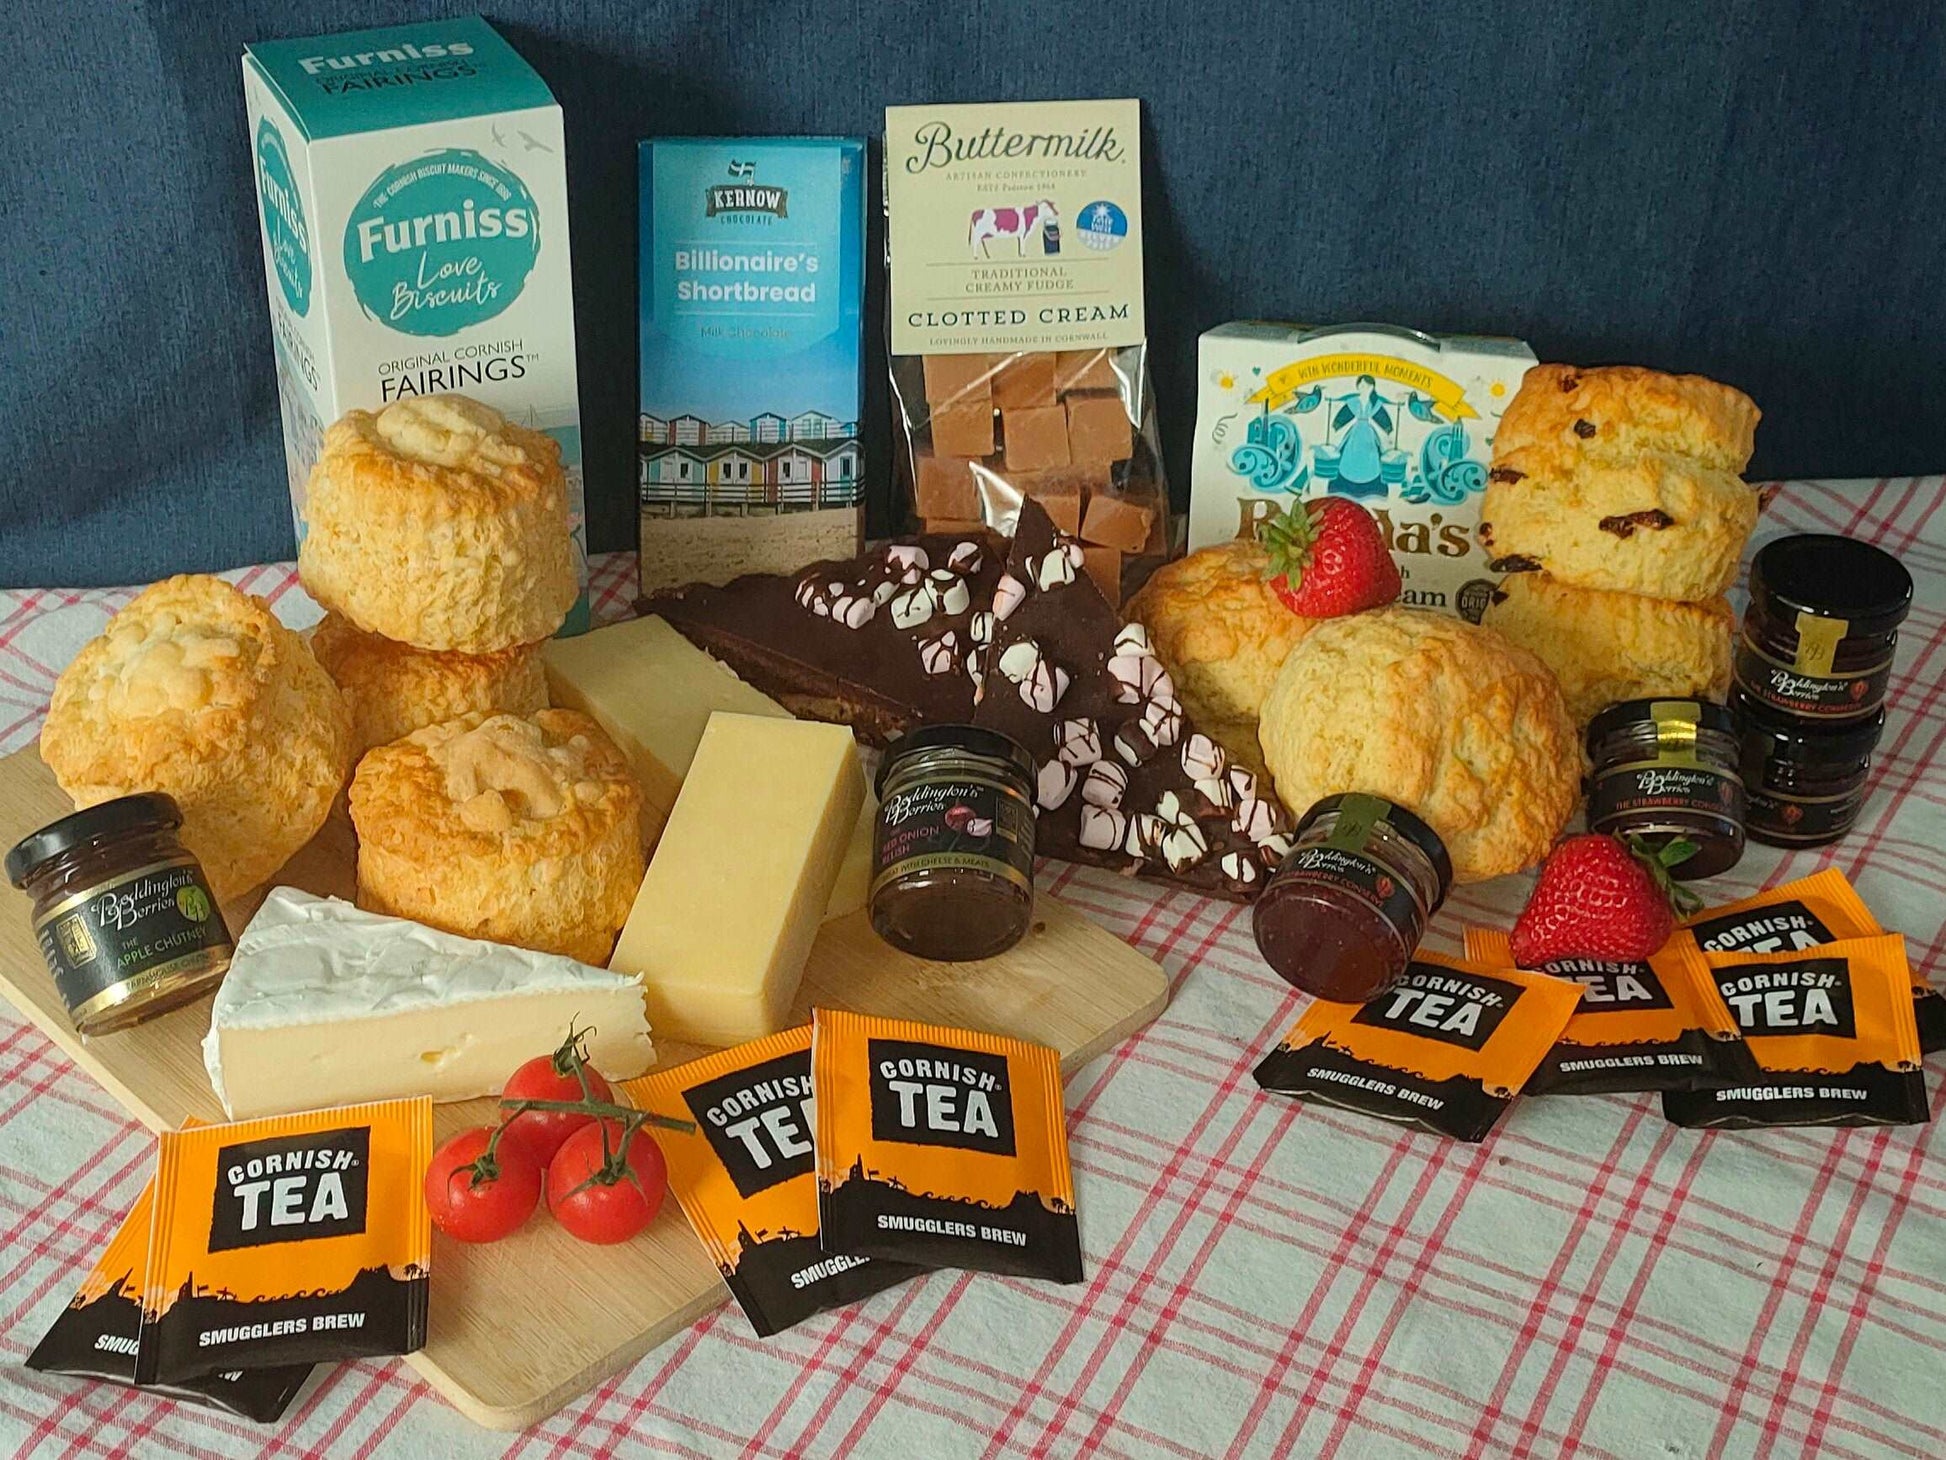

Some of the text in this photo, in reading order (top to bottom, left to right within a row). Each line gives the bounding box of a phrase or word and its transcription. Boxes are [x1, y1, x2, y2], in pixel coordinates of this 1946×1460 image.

[298, 42, 474, 75] Furniss
[321, 65, 477, 94] FAIRINGS
[906, 120, 1126, 174] Buttermilk
[417, 162, 447, 180] BISCUIT
[446, 162, 479, 180] MAKERS
[259, 154, 307, 254] Furniss
[714, 188, 781, 209] KERNOW
[357, 199, 530, 264] Furniss
[720, 214, 772, 226] CHOCOLATE
[418, 250, 483, 289] Love
[675, 249, 819, 273] Billionaire's
[971, 266, 1067, 281] TRADITIONAL
[390, 267, 503, 321] Biscuits
[677, 281, 816, 302] Shortbread
[965, 279, 1074, 293] CREAMY FUDGE
[700, 325, 722, 339] Milk
[908, 303, 1130, 328] CLOTTED CREAM
[981, 334, 1039, 346] HANDMADE
[1041, 334, 1052, 344] IN
[378, 339, 523, 376] ORIGINAL CORNISH
[900, 826, 940, 841] ONION
[117, 944, 154, 969] APPLE
[154, 926, 207, 952] CHUTNEY
[122, 936, 139, 951] THE
[1704, 915, 1807, 952] CORNISH
[1536, 959, 1638, 975] ORNISH
[1399, 973, 1499, 1009] CORNISH
[1563, 975, 1653, 1002] EA
[1720, 972, 1836, 997] CORNISH
[1385, 988, 1485, 1037] TEA
[1728, 988, 1839, 1027] TEA
[879, 1058, 996, 1092] CORNISH
[1559, 1054, 1703, 1073] SMUGGLERS BREW
[706, 1074, 816, 1127] CORNISH
[1306, 1067, 1445, 1112] SMUGGLERS BREW
[1716, 1086, 1868, 1101] SMUGGLERS BREW
[888, 1081, 999, 1139] TEA
[227, 1149, 352, 1184] CORNISH
[232, 1172, 349, 1231] TEA
[877, 1214, 1027, 1247] SMUGGLERS BREW
[199, 1312, 366, 1348] SMUGGLERS BREW
